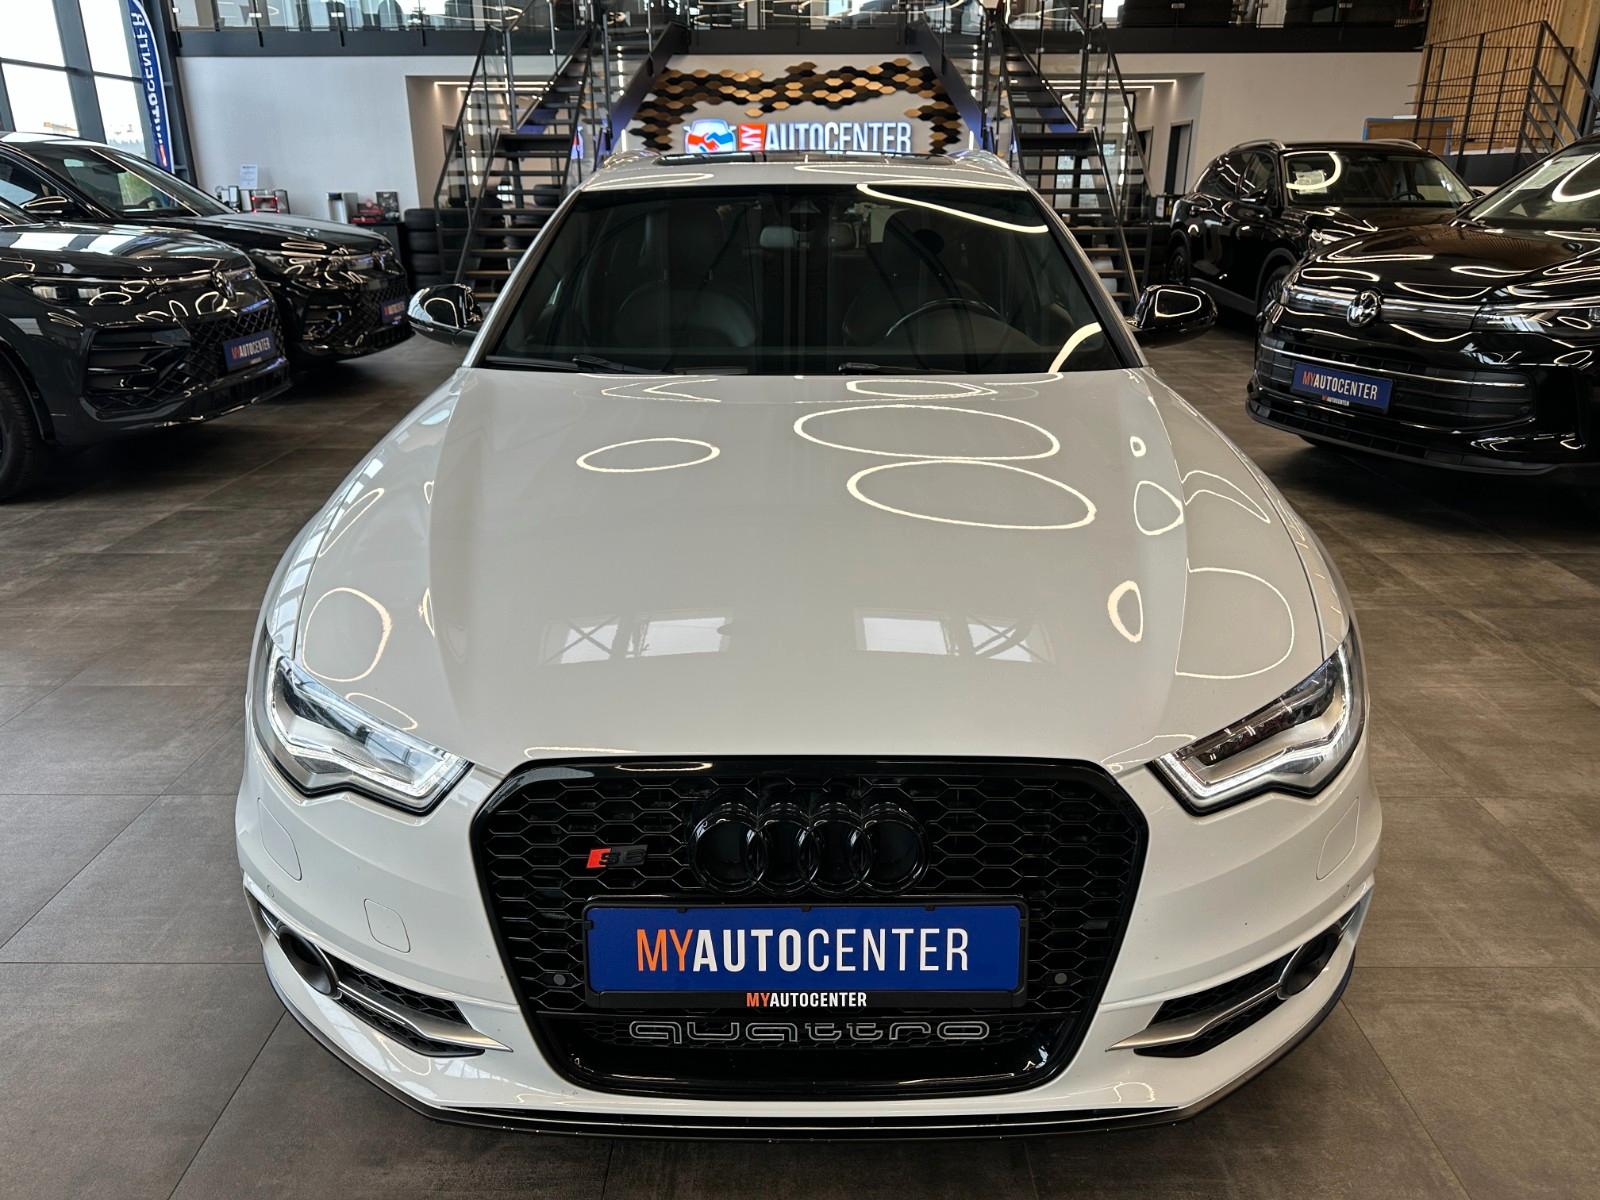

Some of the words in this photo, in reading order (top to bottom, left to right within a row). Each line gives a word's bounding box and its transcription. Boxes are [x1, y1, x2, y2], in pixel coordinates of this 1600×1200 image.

[765, 121, 912, 152] AUTOCENTER
[1302, 371, 1378, 400] MYAUTOCENTER
[636, 928, 969, 973] MYAUTOCENTER
[746, 992, 867, 1008] MYAUTOCENTER
[629, 1020, 990, 1044] quattro
